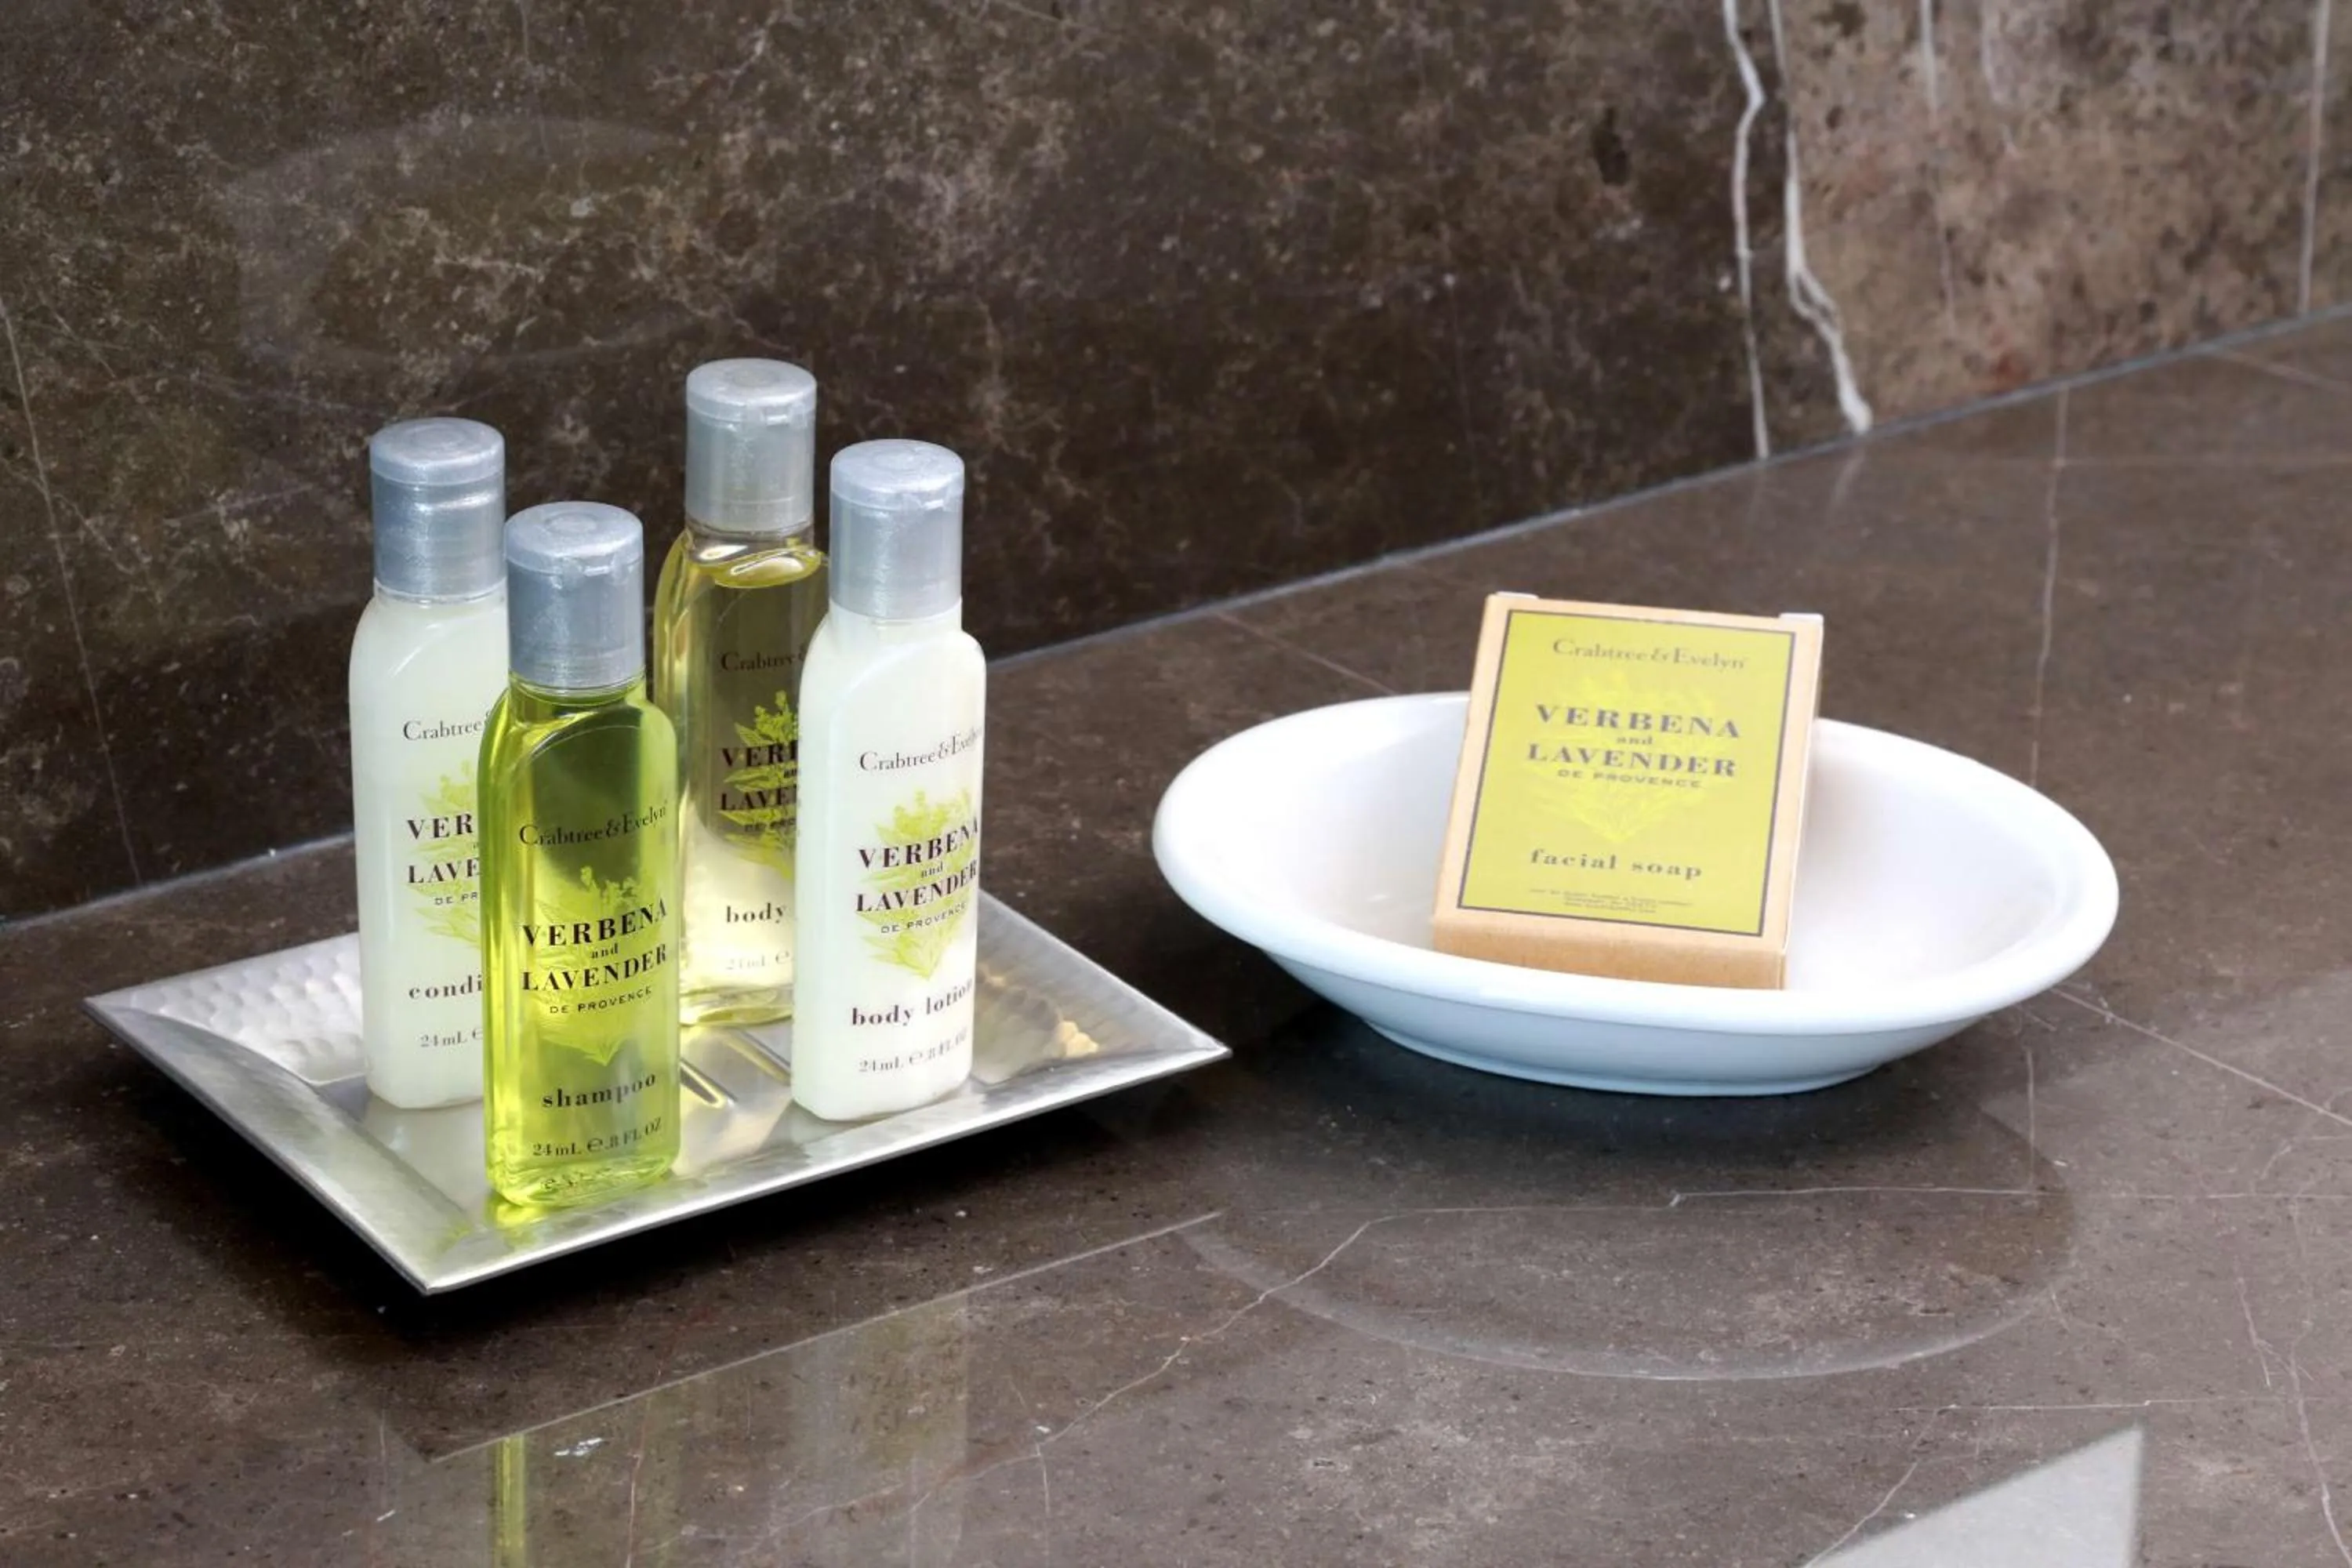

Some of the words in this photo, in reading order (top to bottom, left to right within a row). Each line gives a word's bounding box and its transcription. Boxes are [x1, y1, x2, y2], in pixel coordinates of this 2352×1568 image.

[1536, 703, 1741, 739] VERBENA
[1616, 735, 1653, 746] and
[1527, 742, 1737, 778] LAVENDER
[858, 816, 978, 869] VERBENA
[1530, 848, 1617, 870] facial
[1631, 860, 1702, 880] soap
[856, 859, 977, 913] LAVENDER
[522, 898, 666, 947] VERBENA
[727, 902, 787, 924] body
[522, 943, 666, 991] LAVENDER
[591, 942, 619, 959] and
[550, 1005, 569, 1014] DE
[578, 985, 652, 1012] PROVENCE
[851, 1004, 914, 1027] body
[926, 978, 972, 1015] lotion
[542, 1073, 655, 1108] shampoo
